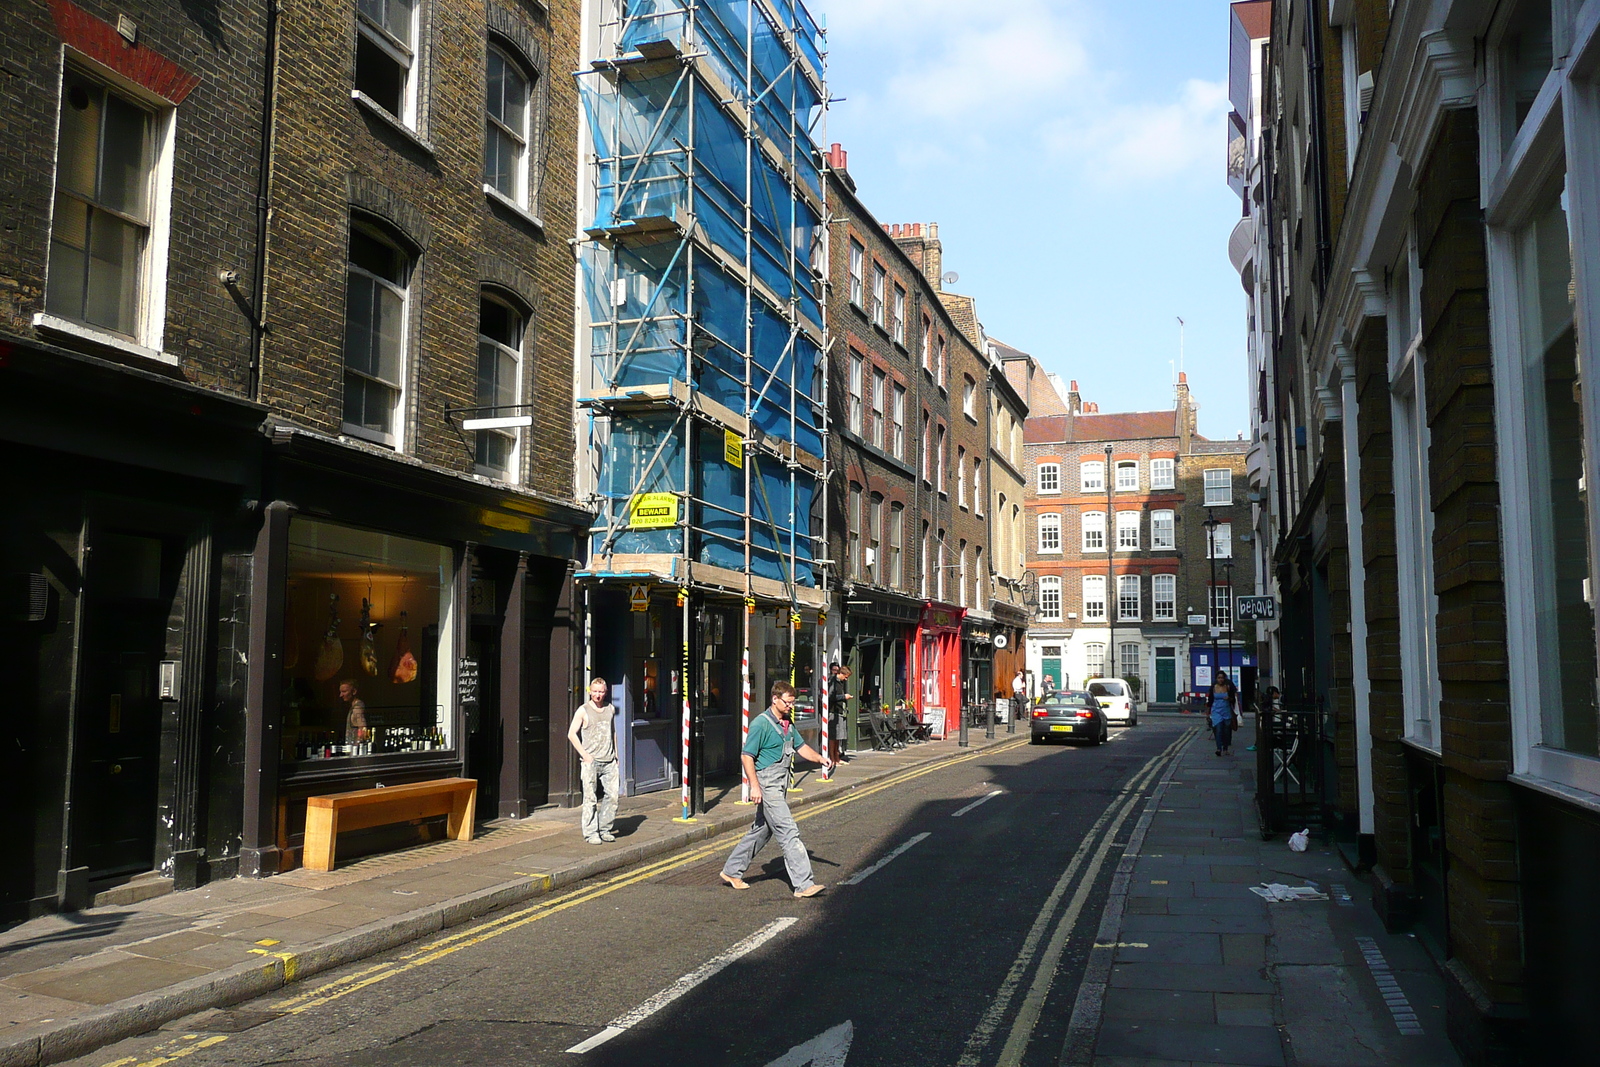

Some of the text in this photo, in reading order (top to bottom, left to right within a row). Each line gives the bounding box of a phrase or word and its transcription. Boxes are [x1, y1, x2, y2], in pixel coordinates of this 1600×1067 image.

[652, 495, 676, 504] ALARMS
[639, 507, 668, 516] BEWARE
[1240, 598, 1273, 617] behave
